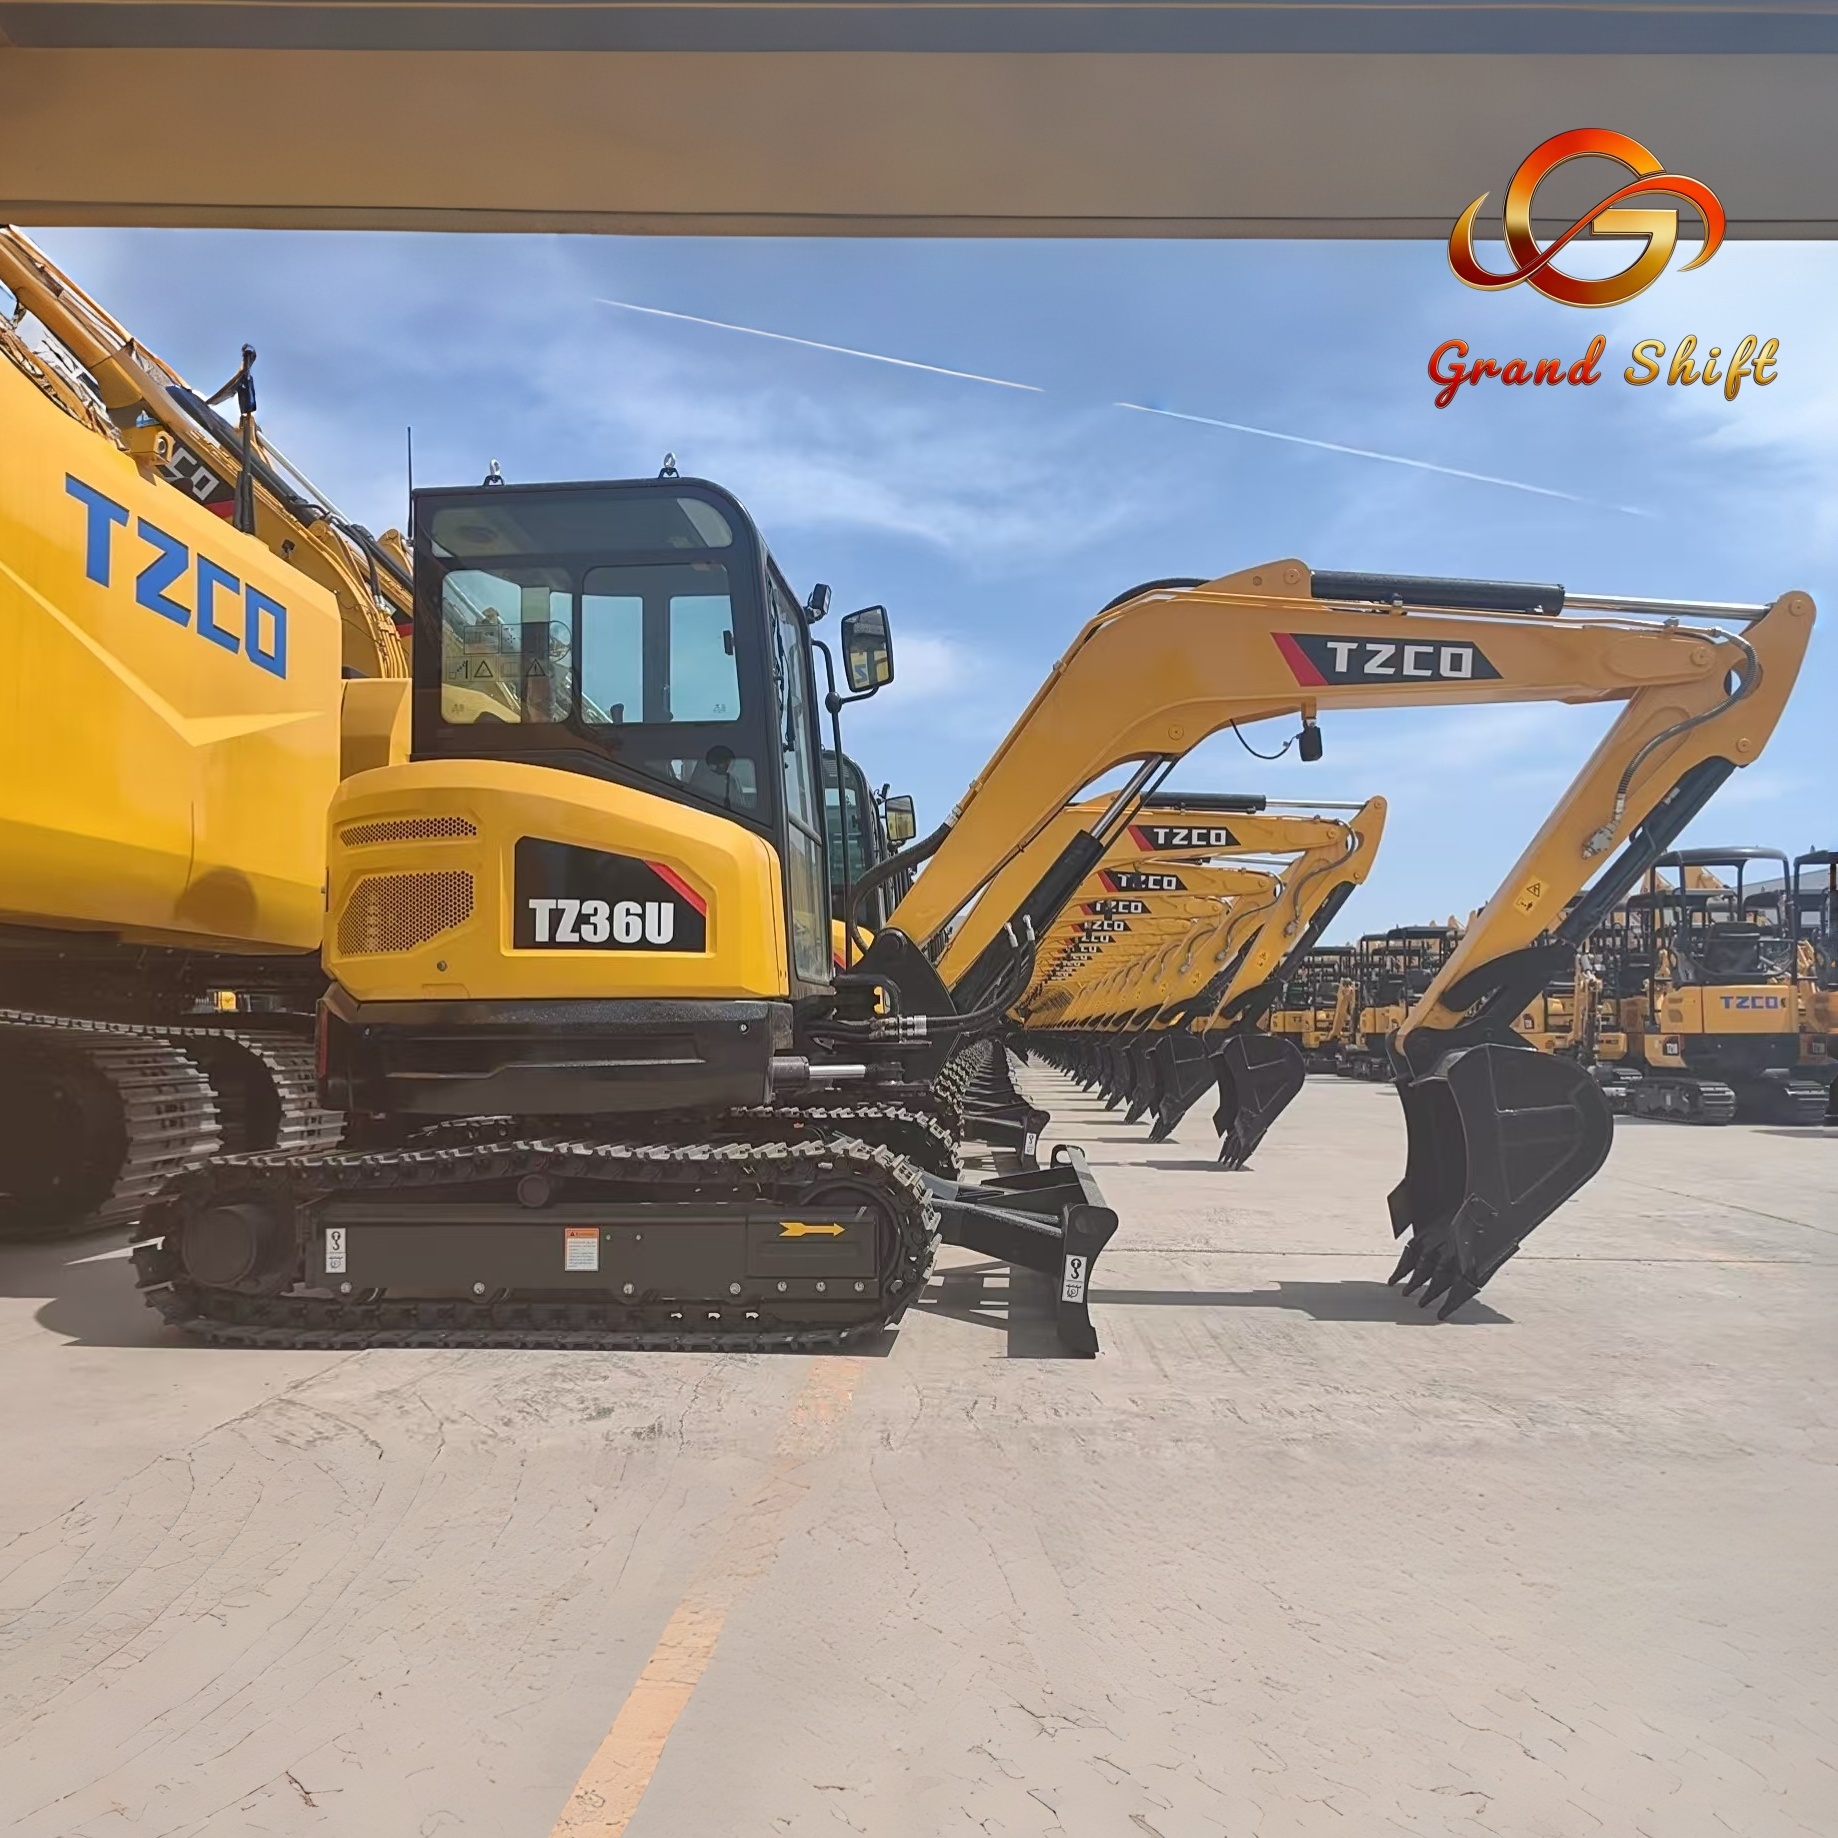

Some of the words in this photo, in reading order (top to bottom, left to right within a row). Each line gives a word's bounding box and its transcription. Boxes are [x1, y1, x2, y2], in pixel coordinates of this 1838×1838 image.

[65, 472, 287, 680] TZCO
[1326, 641, 1474, 679] TZCO
[1153, 828, 1227, 846] TZCO
[528, 898, 675, 945] TZ36U
[1719, 995, 1779, 1009] TZCO
